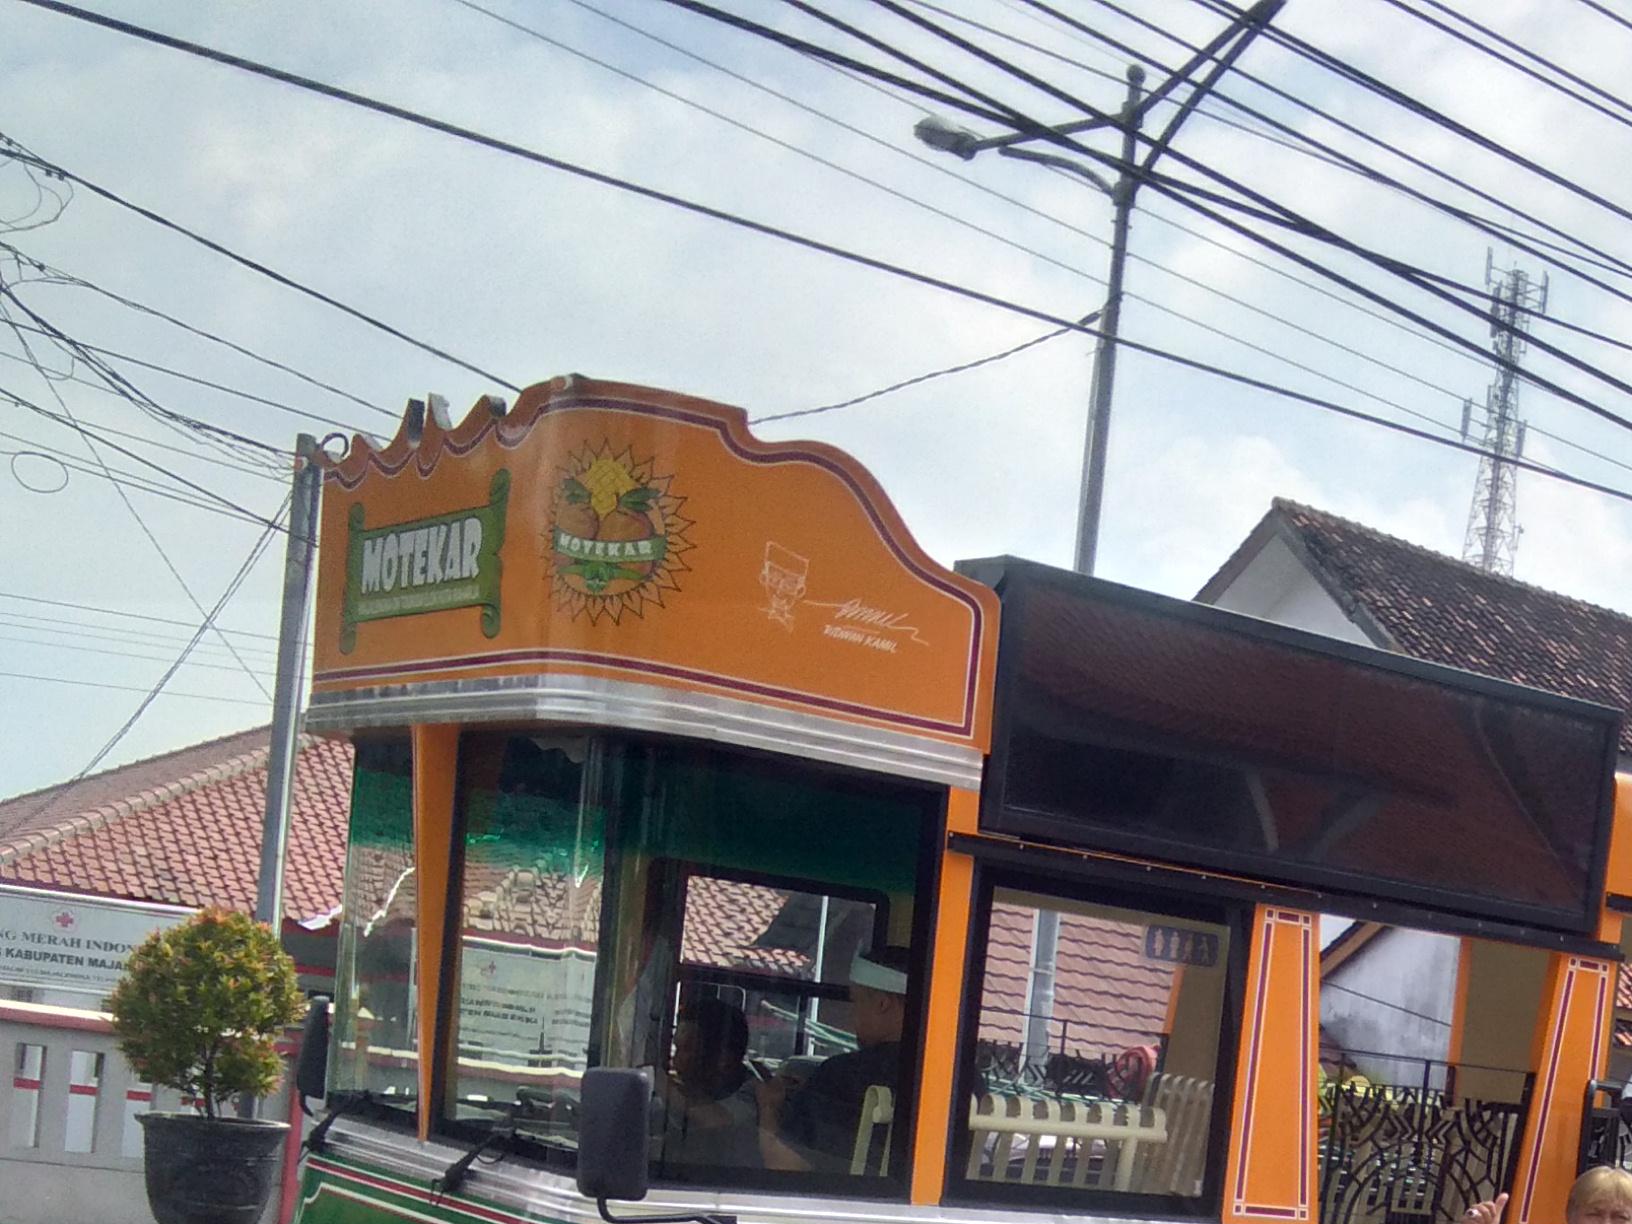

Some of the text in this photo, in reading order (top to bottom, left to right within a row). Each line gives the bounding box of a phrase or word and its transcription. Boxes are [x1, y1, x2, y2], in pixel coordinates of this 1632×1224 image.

[361, 517, 482, 594] MOTEKAR
[560, 533, 652, 556] MOTEKAR
[22, 931, 82, 949] MERAH
[5, 947, 129, 971] KABUPATEN MAJA
